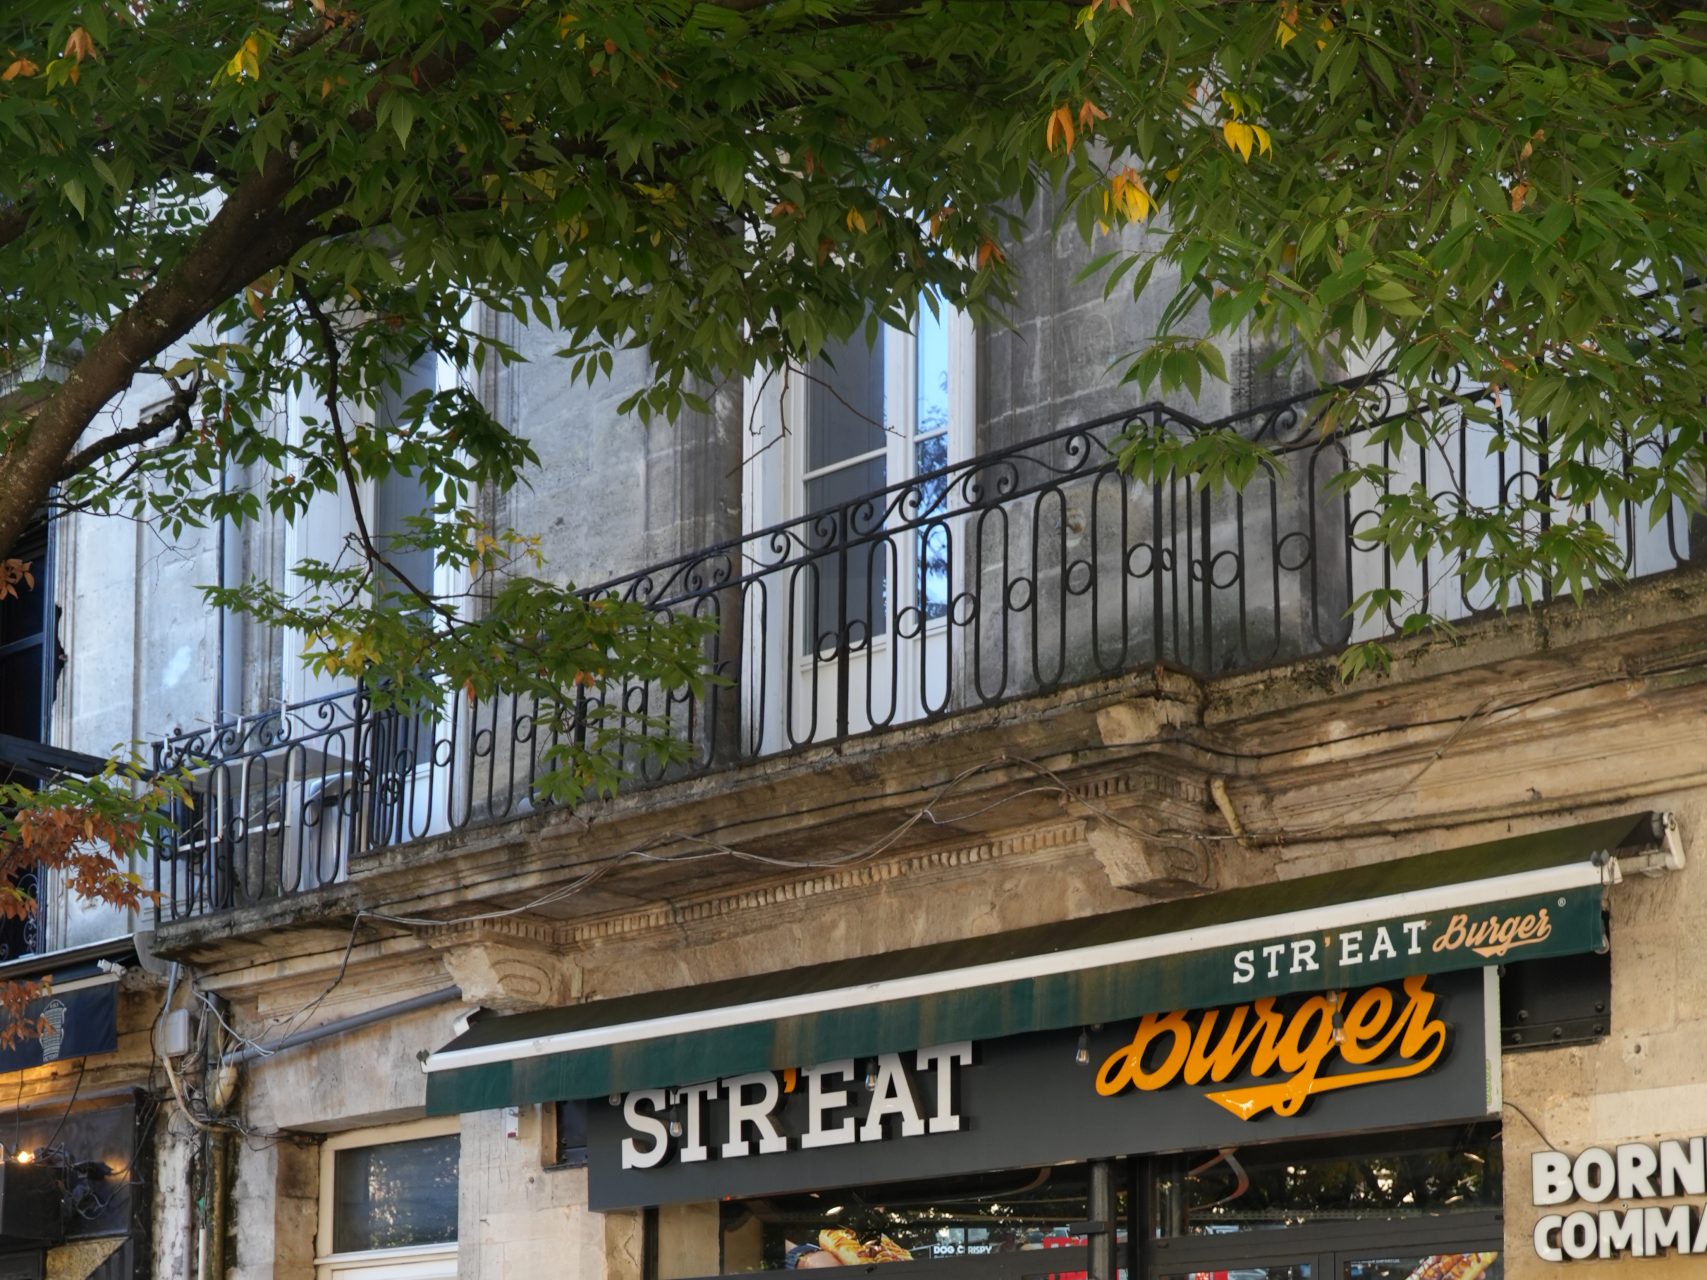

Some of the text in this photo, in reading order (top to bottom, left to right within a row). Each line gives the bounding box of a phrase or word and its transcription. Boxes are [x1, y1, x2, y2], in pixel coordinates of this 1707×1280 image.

[1232, 907, 1552, 984] STR'EAT Burger
[621, 974, 1446, 1169] STR'EAT Burger
[933, 1245, 955, 1255] DOG
